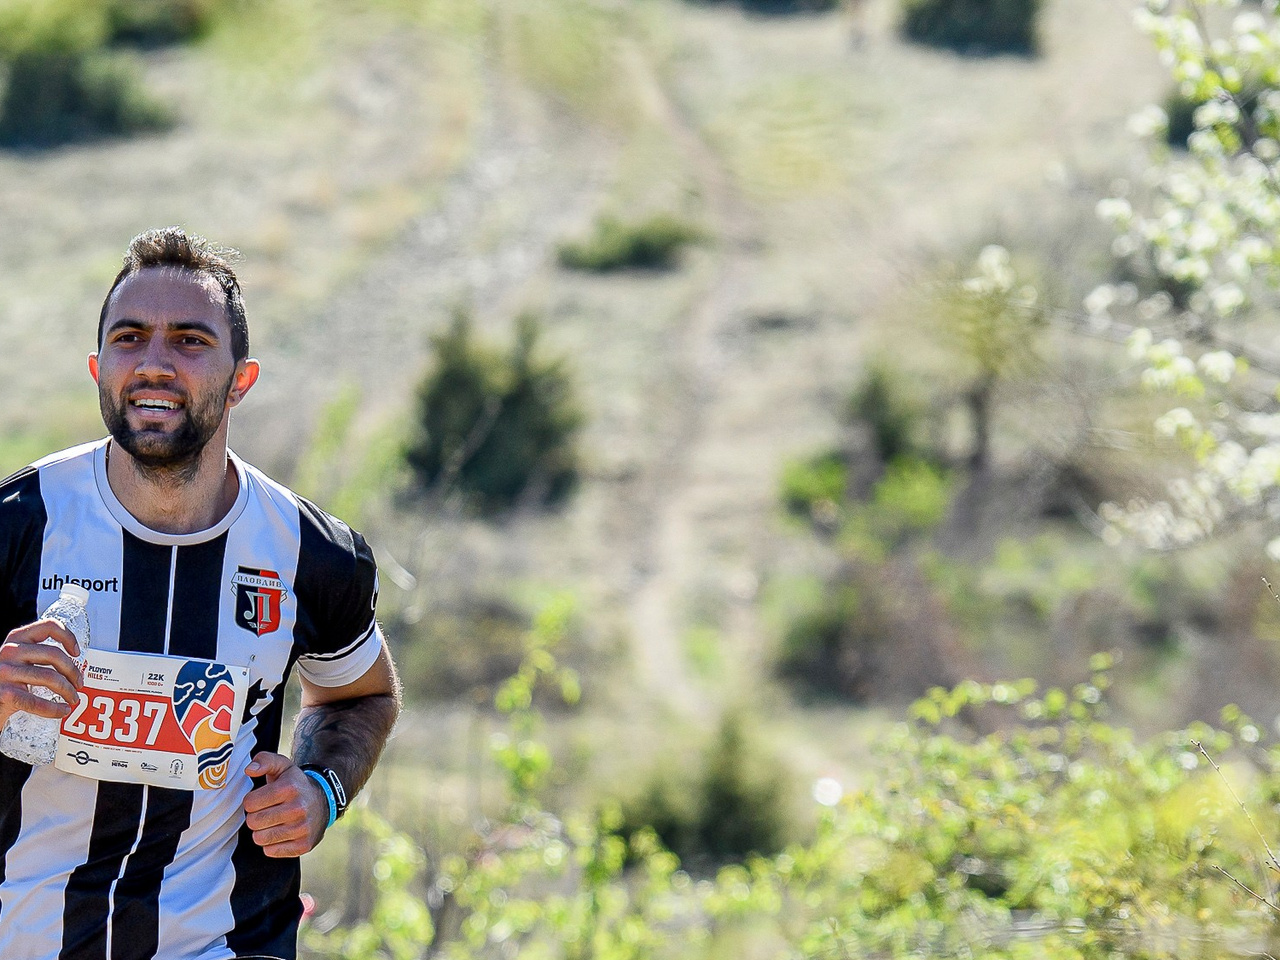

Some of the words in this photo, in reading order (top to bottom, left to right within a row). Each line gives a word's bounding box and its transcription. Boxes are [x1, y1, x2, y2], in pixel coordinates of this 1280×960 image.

[42, 574, 118, 592] uhlsport
[88, 665, 113, 675] PLOVDIV
[87, 672, 104, 681] HILLS
[147, 673, 165, 681] 22K
[63, 692, 168, 746] 2337
